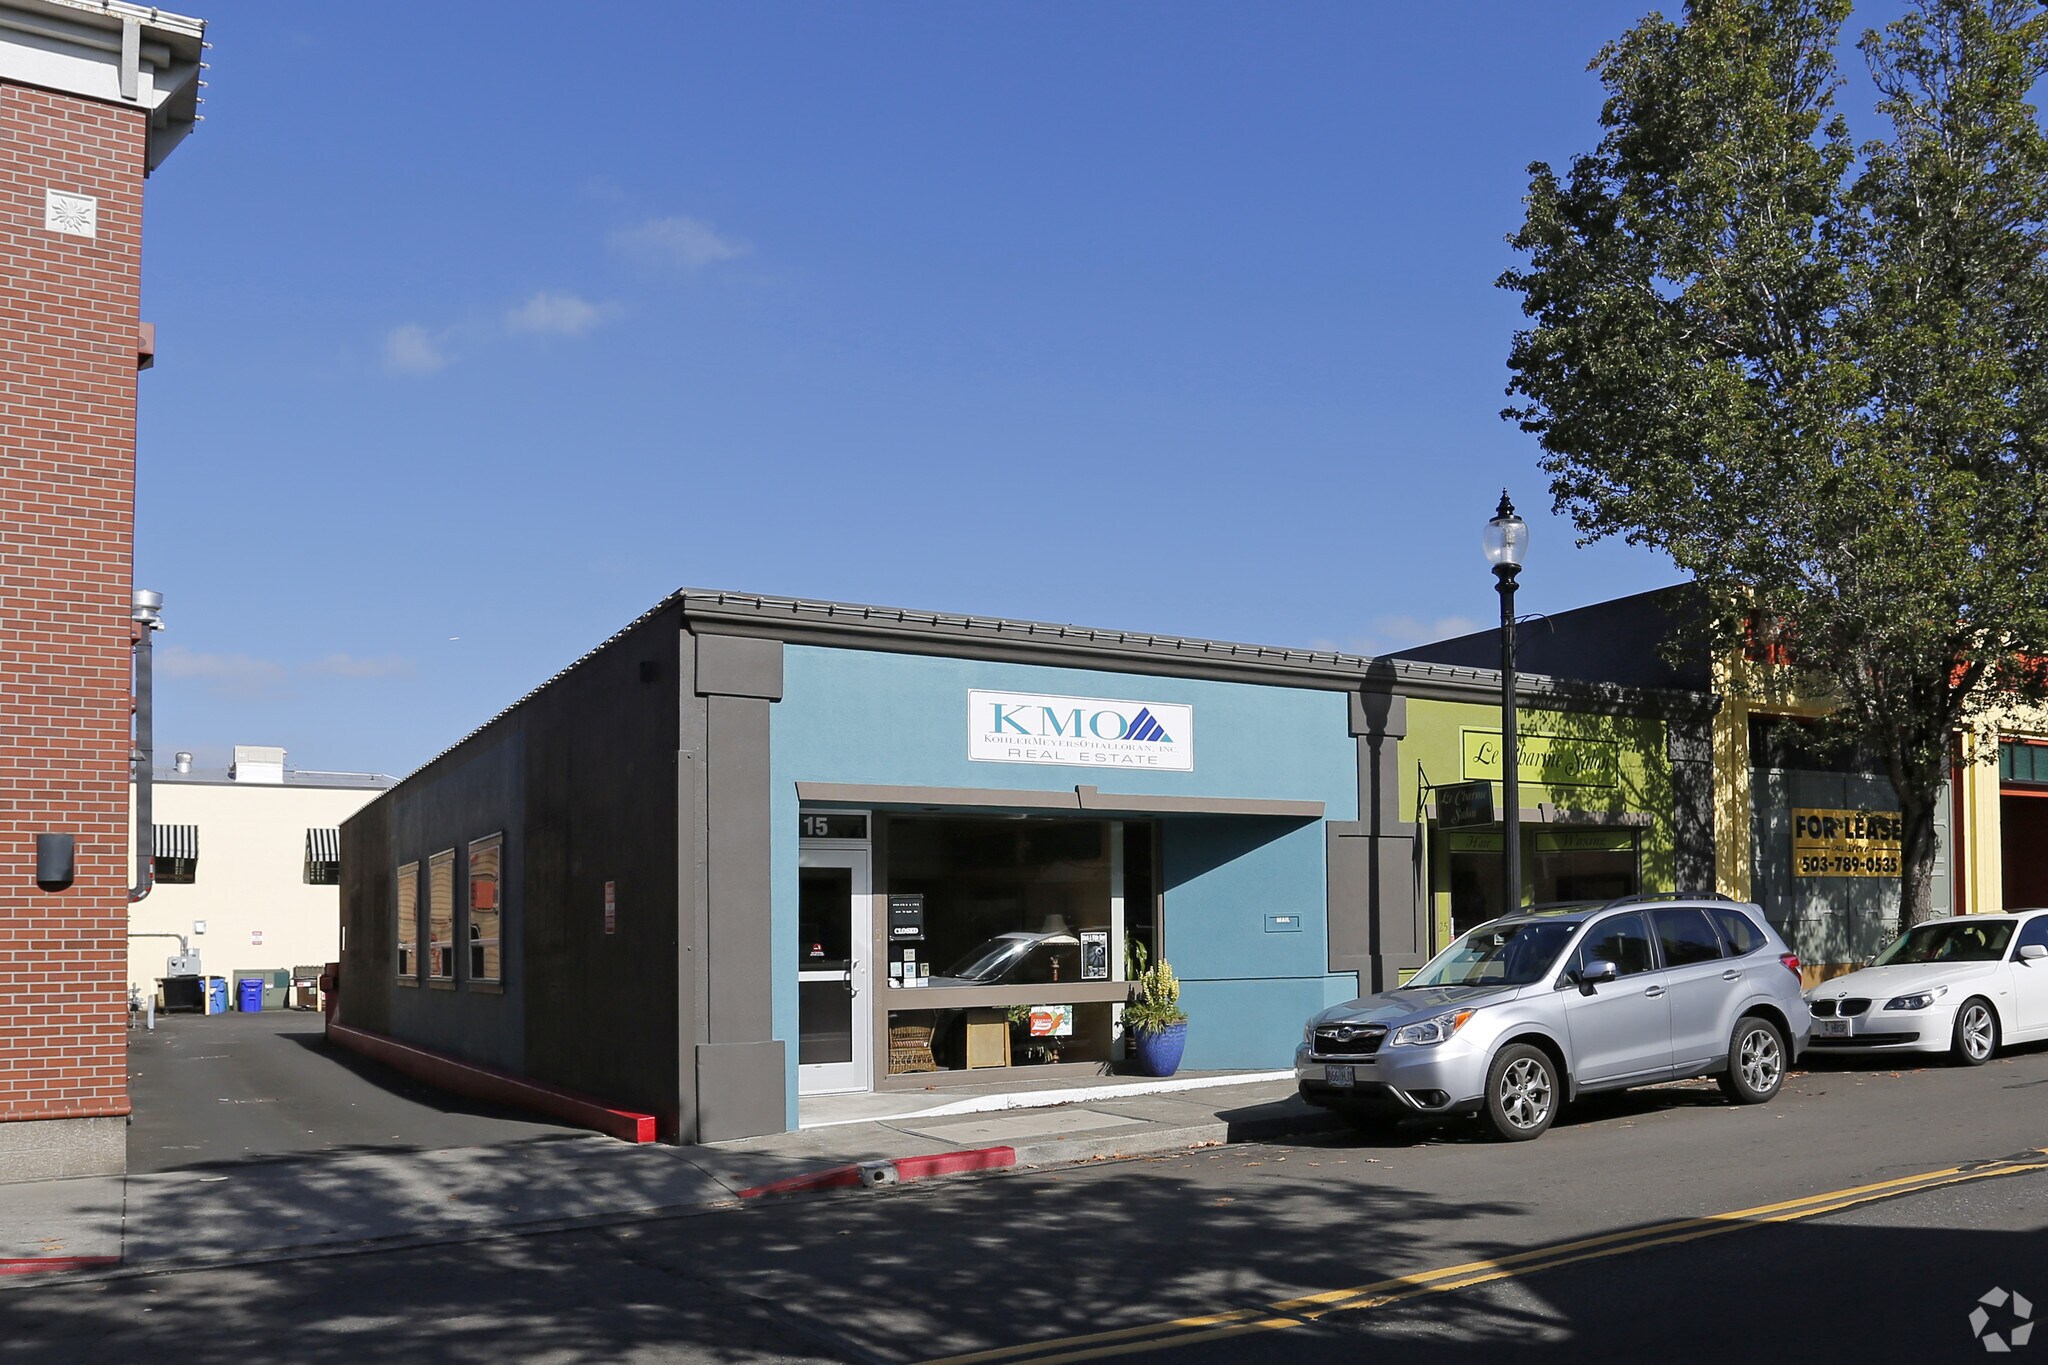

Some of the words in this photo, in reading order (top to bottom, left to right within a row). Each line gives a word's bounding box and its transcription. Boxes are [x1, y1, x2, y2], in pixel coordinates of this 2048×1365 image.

[988, 702, 1128, 740] KMO
[1008, 748, 1065, 760] REAL
[1079, 752, 1158, 765] ESTATE
[1473, 741, 1500, 765] Le
[1516, 743, 1563, 769] harme
[1565, 747, 1610, 776] Salon
[803, 816, 828, 836] 15
[1796, 815, 1838, 839] FOR
[1844, 816, 1902, 841] LEASE
[1802, 856, 1898, 873] 503-789-0535
